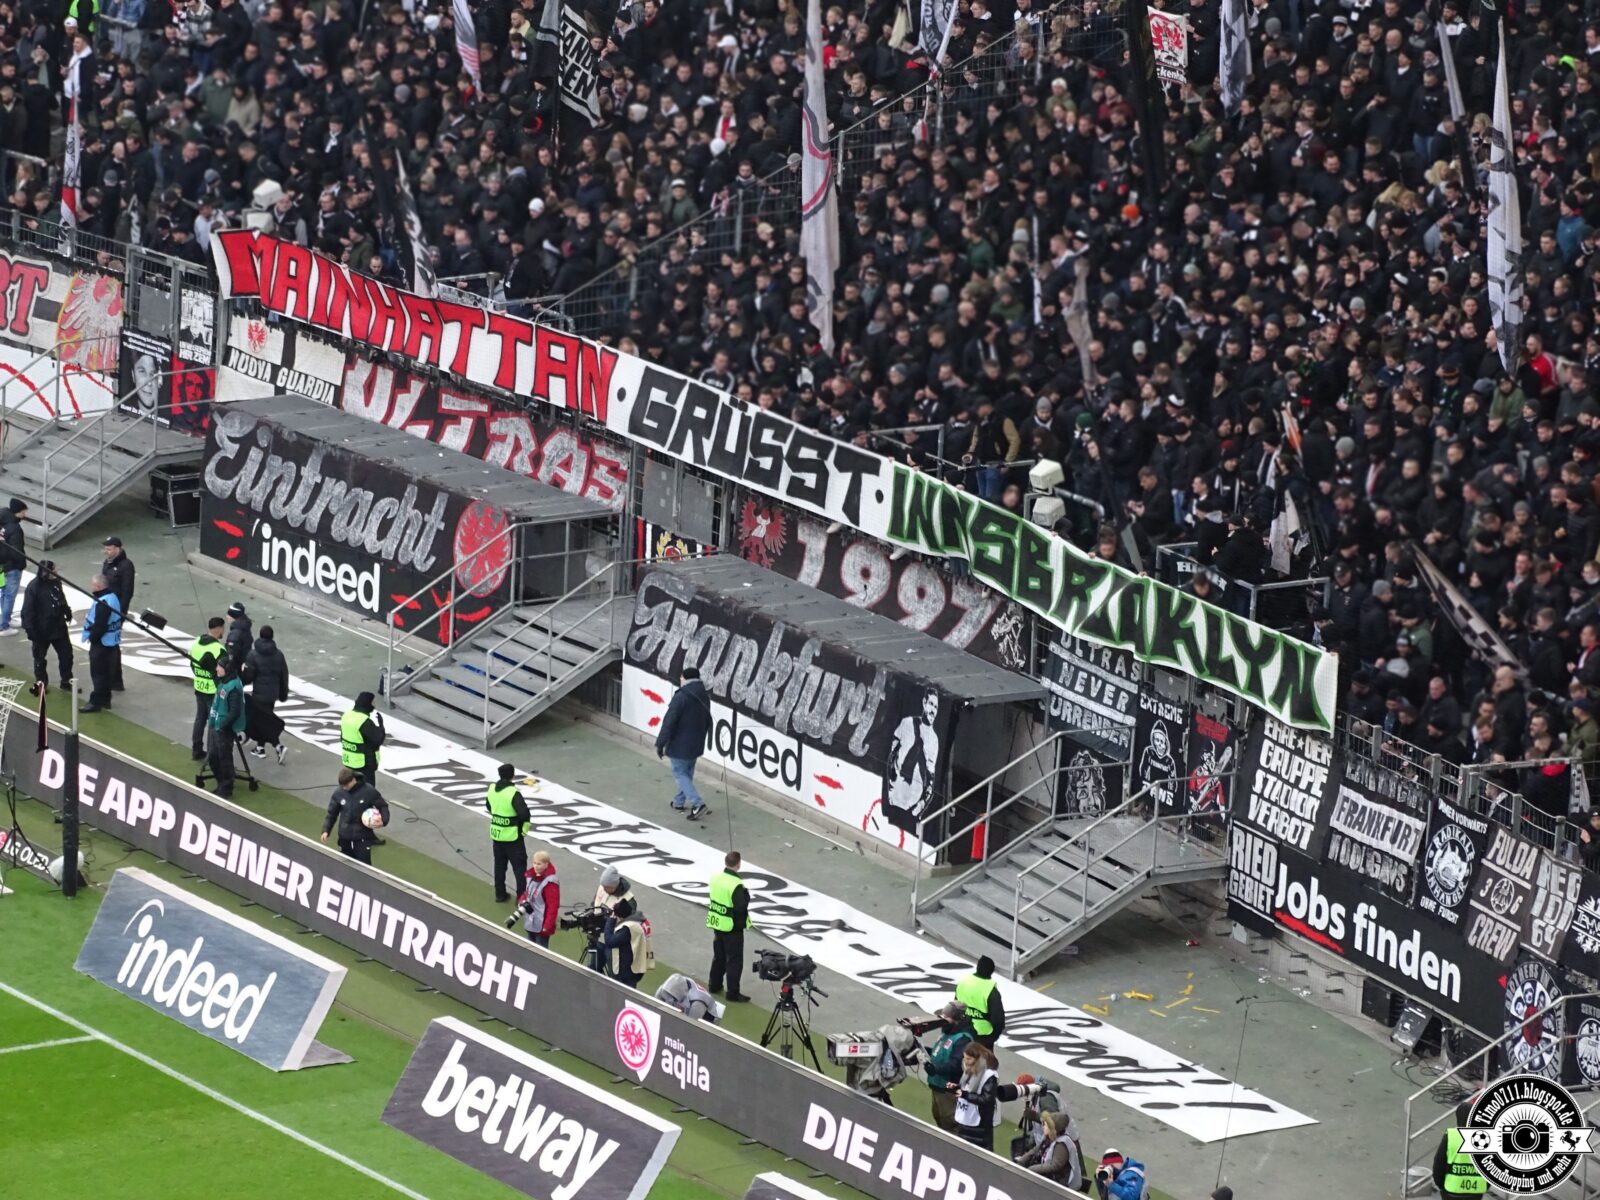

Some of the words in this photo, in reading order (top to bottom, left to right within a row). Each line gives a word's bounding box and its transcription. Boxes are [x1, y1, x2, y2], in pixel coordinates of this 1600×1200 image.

[219, 230, 619, 423] MAINHATTAN
[629, 366, 881, 527] GRÜSST
[228, 347, 272, 383] NUOVA
[276, 366, 335, 405] GUARDIA
[341, 352, 629, 514] ULTRAS
[204, 410, 450, 573] Eintracht
[261, 522, 381, 613] indeed
[797, 519, 1001, 651] 1997
[626, 569, 886, 757] Frankfurt
[1060, 630, 1141, 682] ULTRAS
[1058, 661, 1130, 713] NEVER
[1140, 692, 1183, 725] EXTREME
[1259, 738, 1329, 798] GRUPPE
[1263, 716, 1297, 750] EHRE
[1303, 734, 1333, 767] DER
[1248, 793, 1315, 851] VERBOT
[1252, 769, 1321, 823] STADION
[1335, 795, 1421, 855] FRANKFURT
[1231, 825, 1278, 887] RIED
[1433, 827, 1475, 862] RADIKALE
[1486, 828, 1539, 880] FULDA
[38, 749, 98, 808] DE
[99, 776, 177, 839] APP
[178, 811, 314, 908] DEINER
[316, 884, 538, 1012] EINTRACHT
[1228, 868, 1275, 915] GEBIET
[1479, 877, 1493, 898] 3
[1509, 895, 1524, 915] 6
[1536, 853, 1583, 904] REG
[1274, 862, 1346, 941] Jobs
[1353, 902, 1461, 1004] finden
[1467, 912, 1518, 962] CREW
[1531, 918, 1560, 955] 64
[116, 914, 278, 1044] indeed
[661, 1048, 710, 1093] aqila
[664, 1035, 685, 1054] main
[421, 1039, 620, 1200] betway
[802, 1102, 879, 1173] DIE
[878, 1142, 978, 1200] APP
[1459, 1179, 1478, 1191] 404
